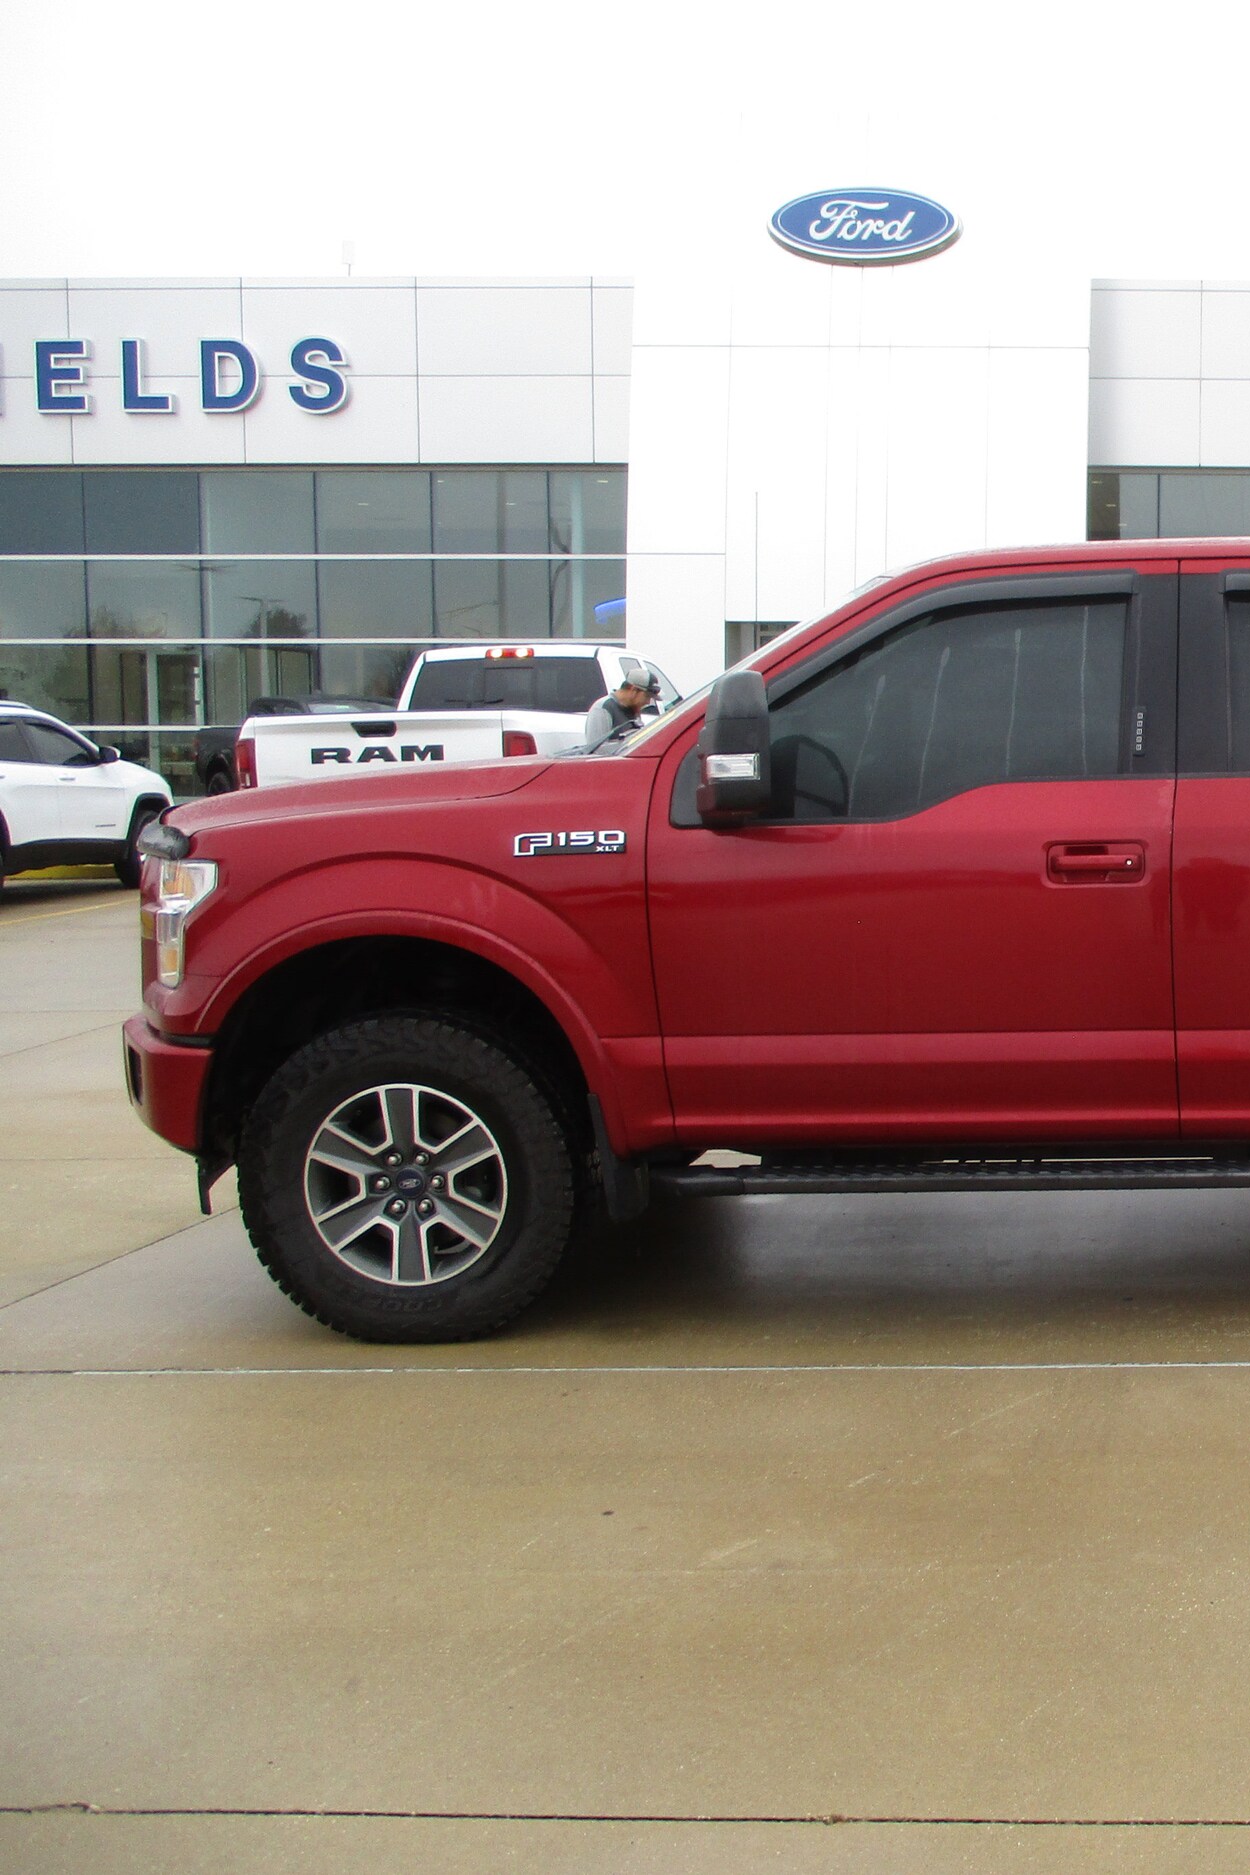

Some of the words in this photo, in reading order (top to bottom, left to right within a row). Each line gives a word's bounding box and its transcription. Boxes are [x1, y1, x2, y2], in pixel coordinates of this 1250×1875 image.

[809, 200, 915, 241] Ford
[0, 337, 349, 414] ELDS
[311, 745, 444, 764] RAM
